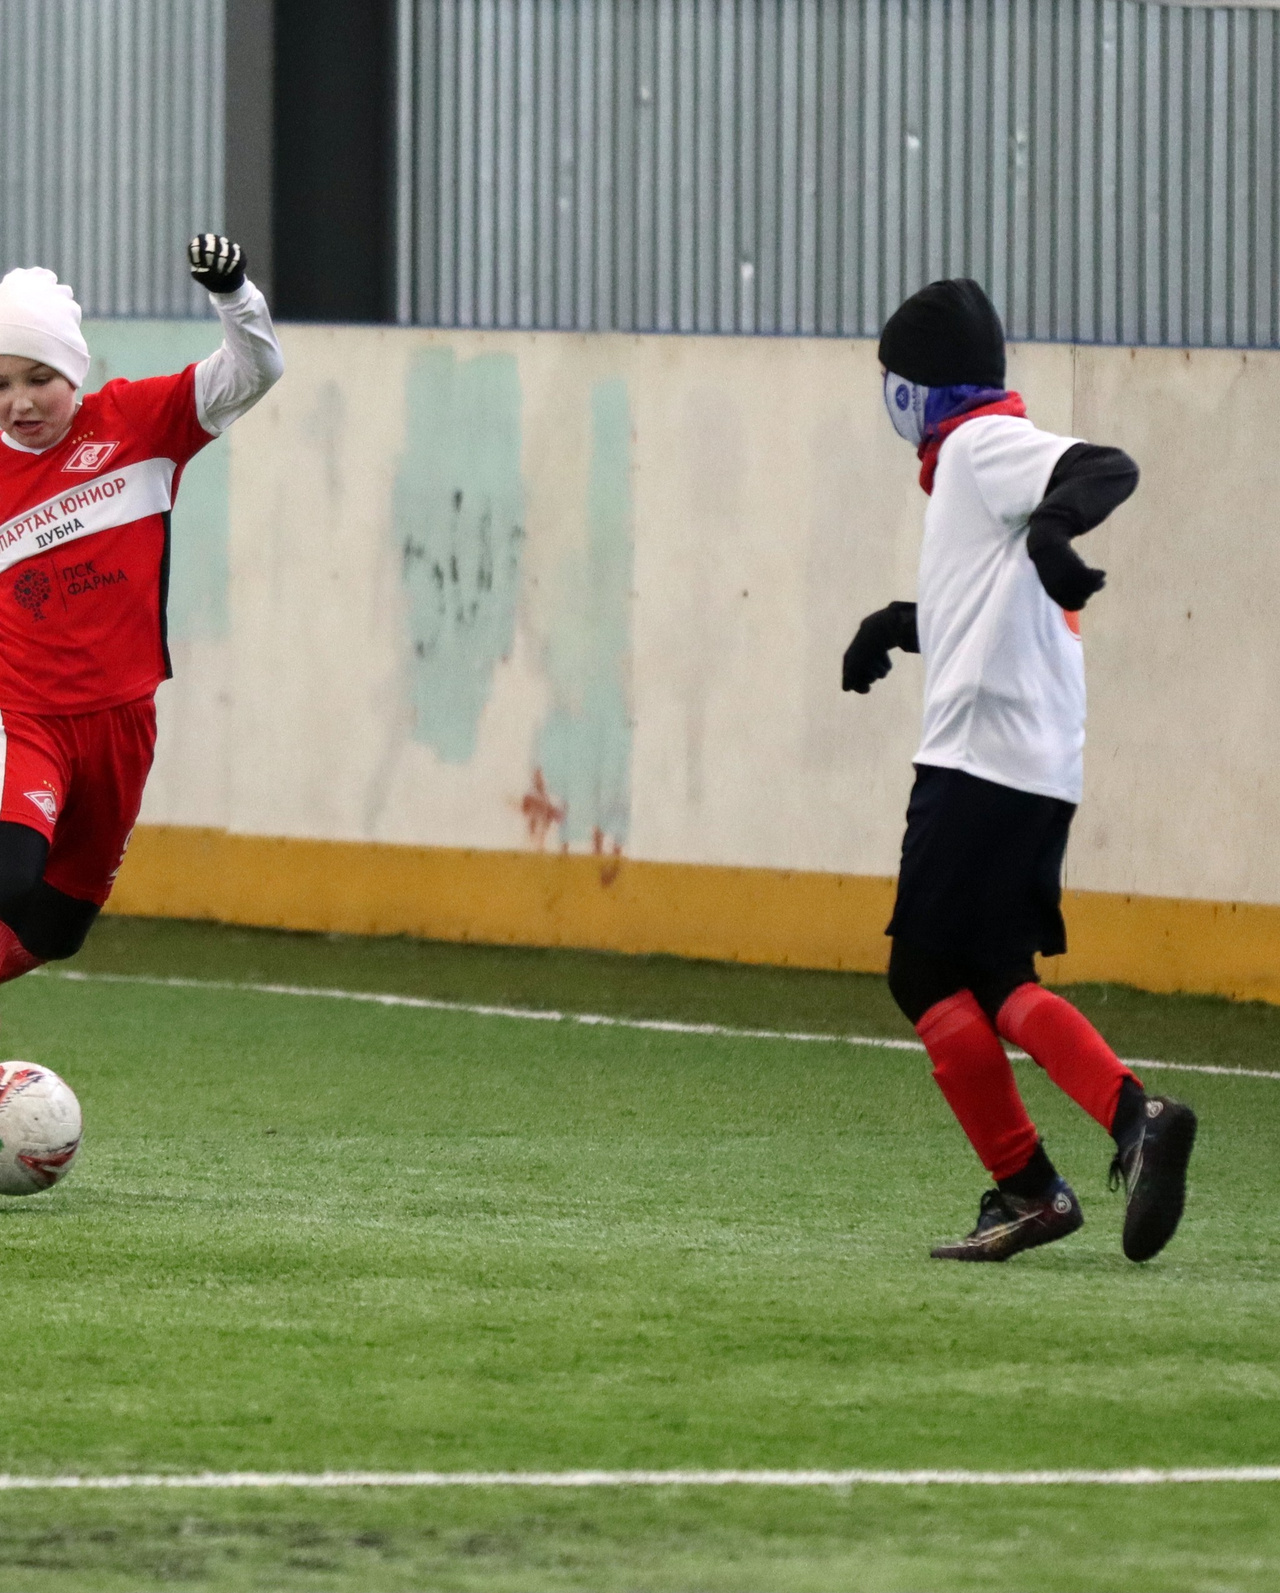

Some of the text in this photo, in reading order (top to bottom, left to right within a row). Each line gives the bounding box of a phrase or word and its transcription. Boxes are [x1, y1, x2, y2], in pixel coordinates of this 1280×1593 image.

[59, 477, 126, 516] ЮНИОР
[35, 518, 85, 549] ДУБНА
[62, 560, 97, 582] ПСК
[67, 569, 129, 596] ФАРМА
